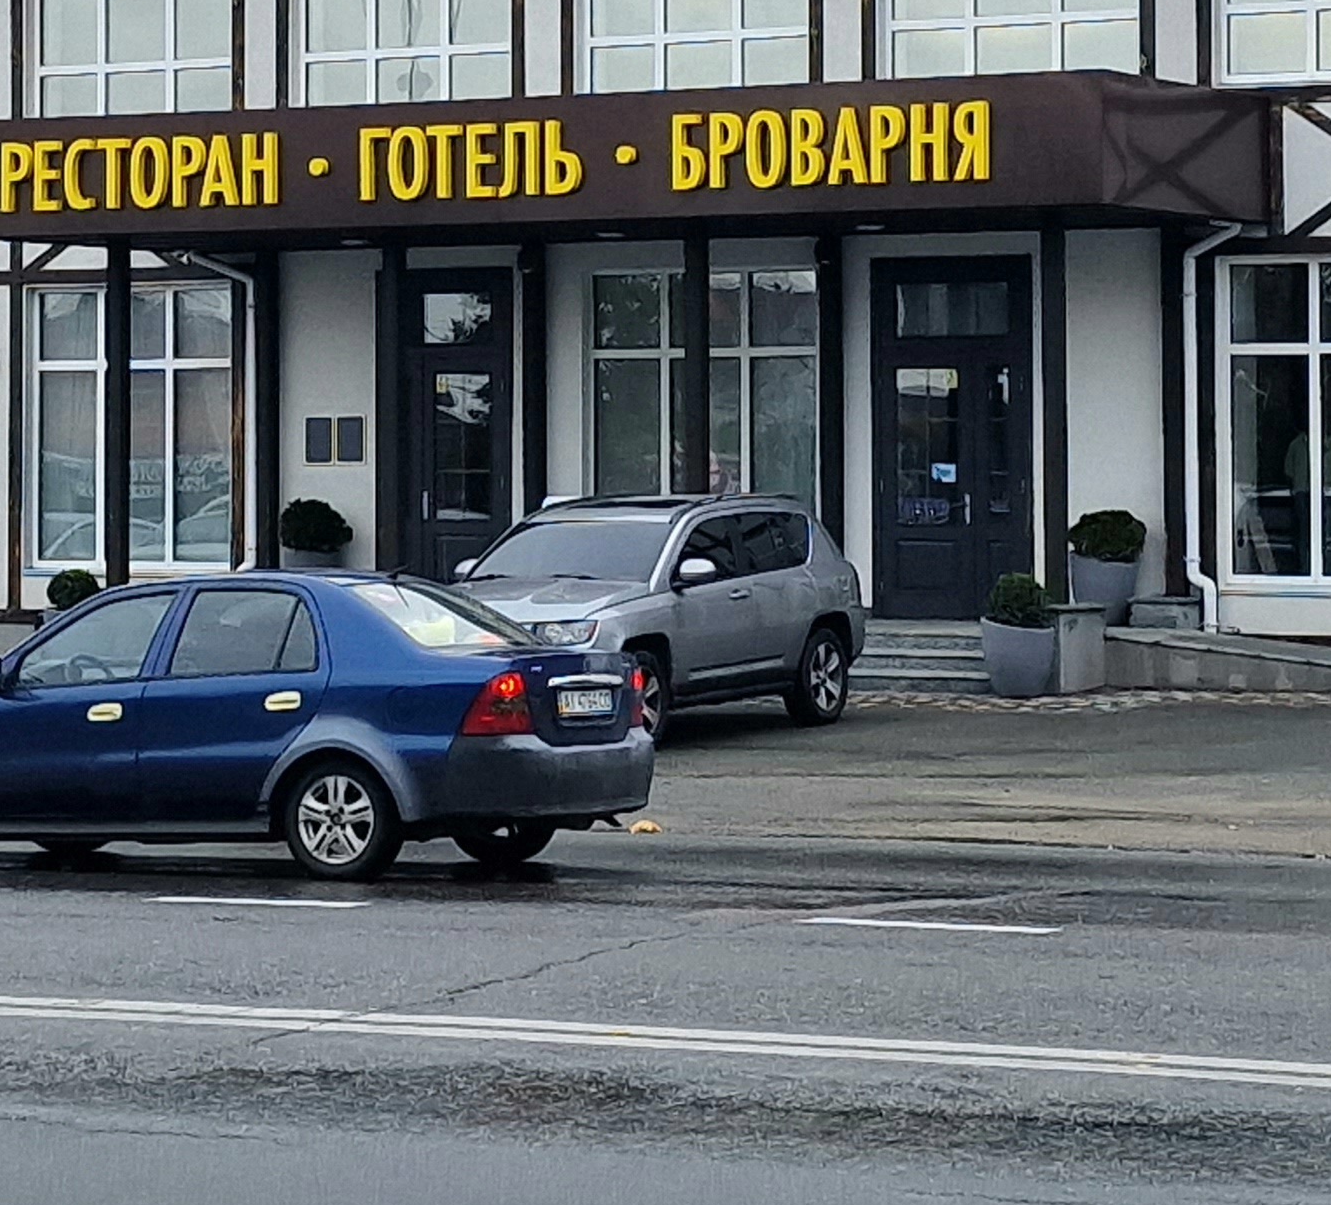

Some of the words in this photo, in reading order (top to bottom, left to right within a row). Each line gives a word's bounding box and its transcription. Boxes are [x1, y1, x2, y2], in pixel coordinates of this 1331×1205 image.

[0, 132, 278, 212] РЕСТОРАН
[360, 120, 582, 201] ГОТЕЛЬ
[672, 101, 989, 190] БРОВАРНЯ
